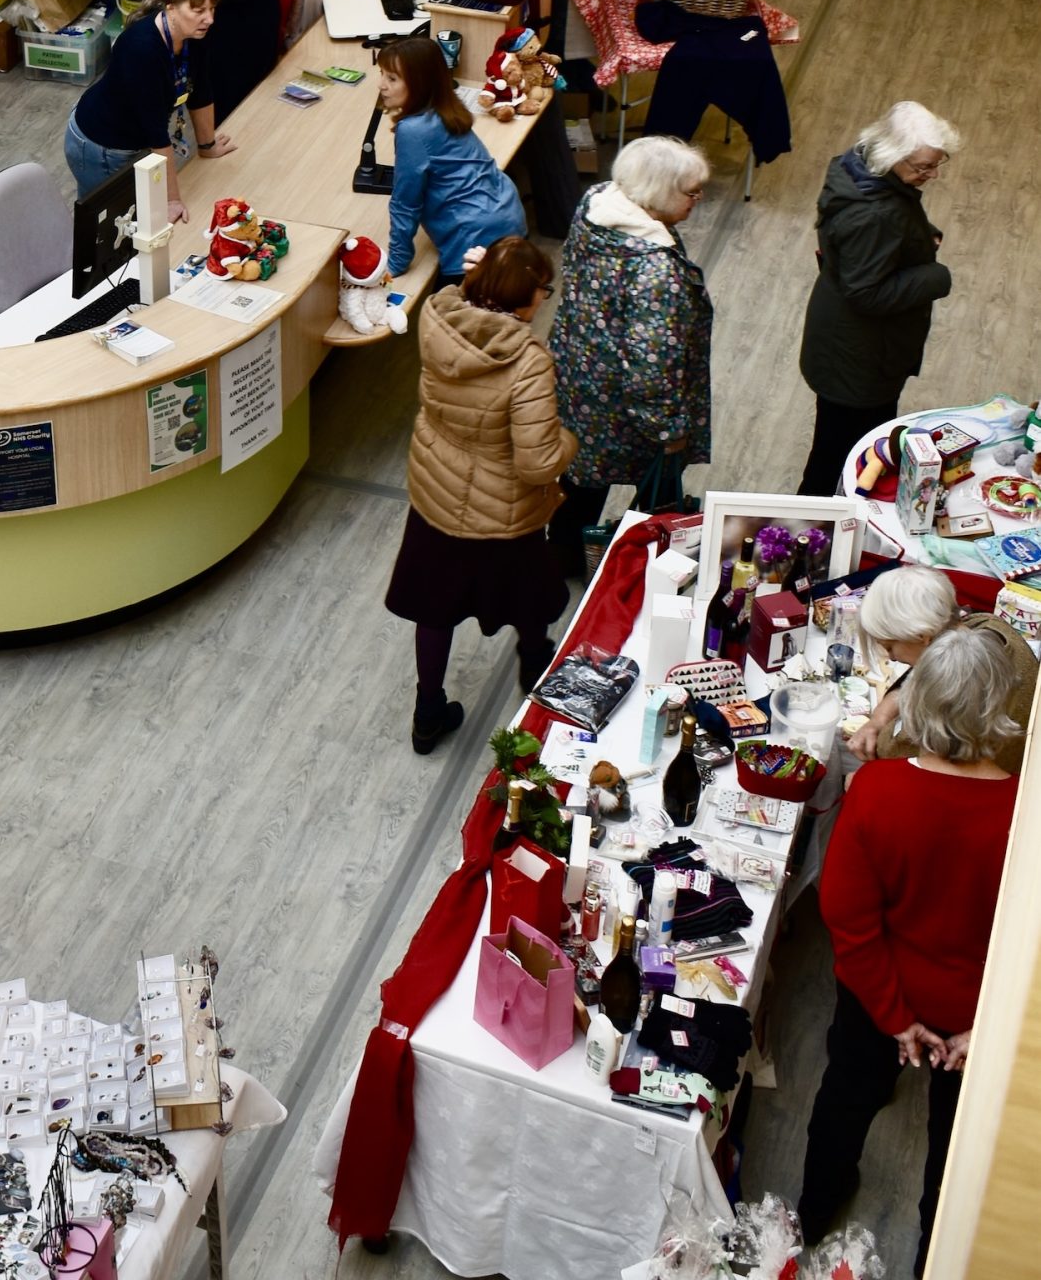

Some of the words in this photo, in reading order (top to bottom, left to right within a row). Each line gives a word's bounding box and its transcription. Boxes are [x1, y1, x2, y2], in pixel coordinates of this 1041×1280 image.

[37, 58, 70, 67] COLLECTION
[42, 51, 63, 59] PATIENT
[231, 362, 250, 378] PLEASE
[250, 353, 264, 367] MAKE
[233, 367, 260, 386] RECEPTION
[229, 383, 248, 398] AWARE
[236, 393, 247, 404] NOT
[247, 386, 260, 398] BEEN
[260, 377, 271, 389] SEEN
[229, 402, 249, 417] WITHIN
[255, 383, 275, 400] MINUTES
[251, 401, 264, 413] YOUR
[229, 410, 264, 436] APPOINTMENT
[12, 429, 41, 437] Somerset
[27, 432, 51, 440] Charity
[241, 434, 257, 449] THANK
[999, 611, 1038, 631] EVER
